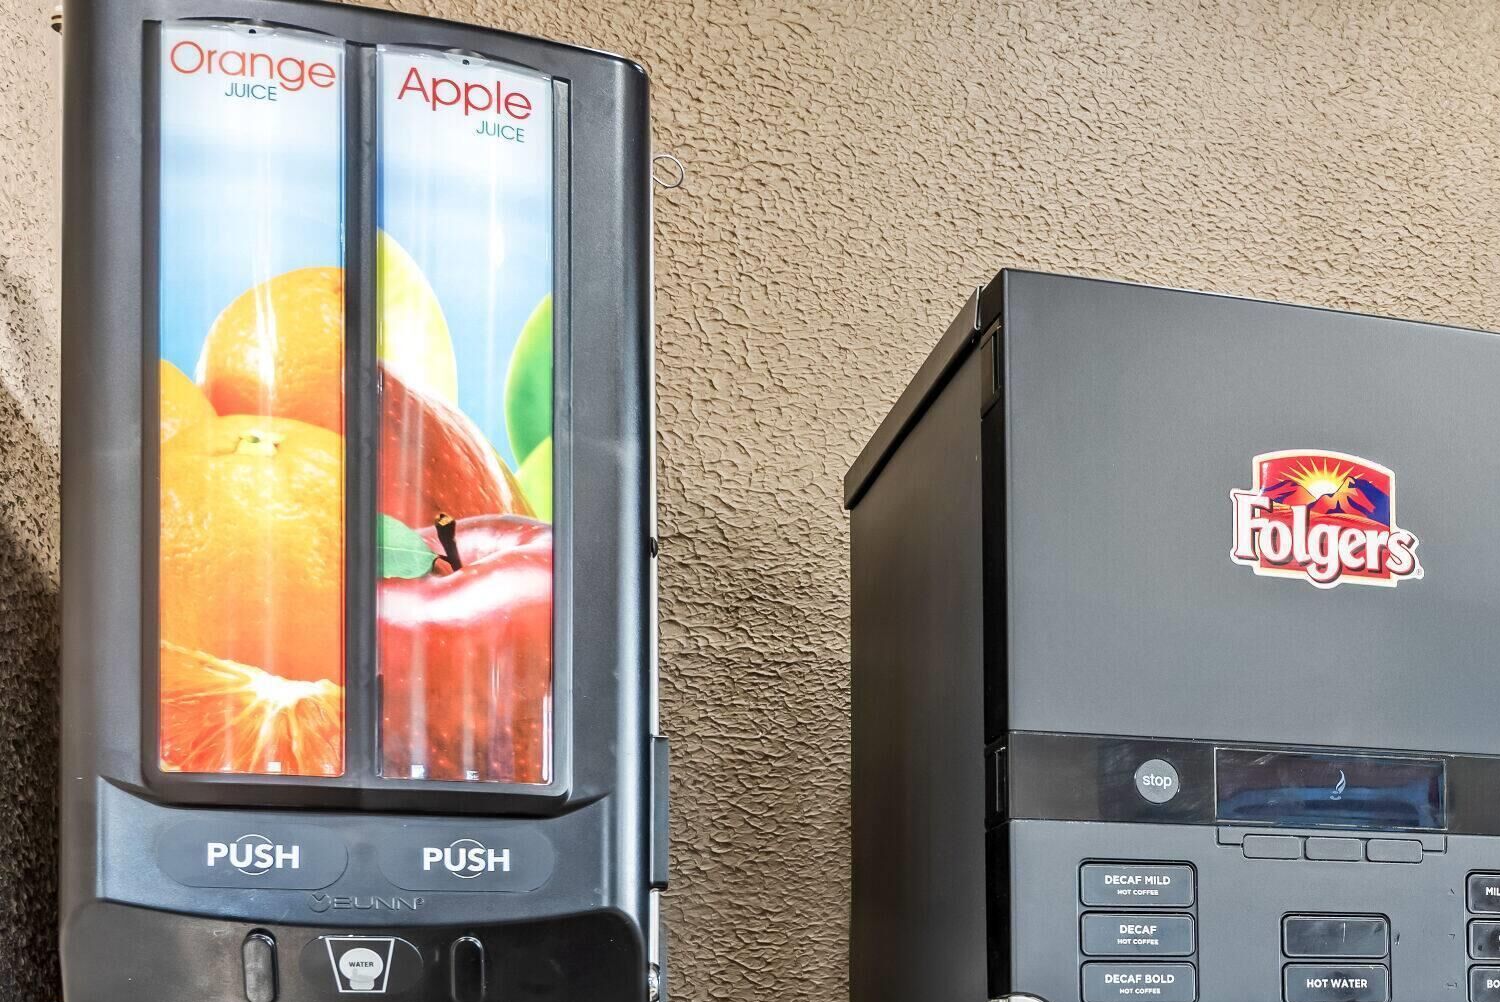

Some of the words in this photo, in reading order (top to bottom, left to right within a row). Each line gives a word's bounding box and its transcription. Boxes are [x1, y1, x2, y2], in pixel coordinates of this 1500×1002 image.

[170, 40, 336, 92] Orange
[224, 82, 278, 102] JUICE
[397, 66, 533, 120] Apple
[475, 119, 525, 143] JUICE
[1233, 492, 1416, 583] Folgers
[1142, 773, 1172, 790] stop
[206, 842, 300, 869] PUSH
[422, 846, 511, 872] PUSH
[1104, 875, 1142, 885] DECAF
[1144, 875, 1171, 885] MILD
[1119, 924, 1157, 934] DECAF
[1104, 974, 1142, 984] DECAF
[1144, 974, 1175, 984] BOLD
[1306, 979, 1329, 988] HOT
[1330, 979, 1368, 989] WATER
